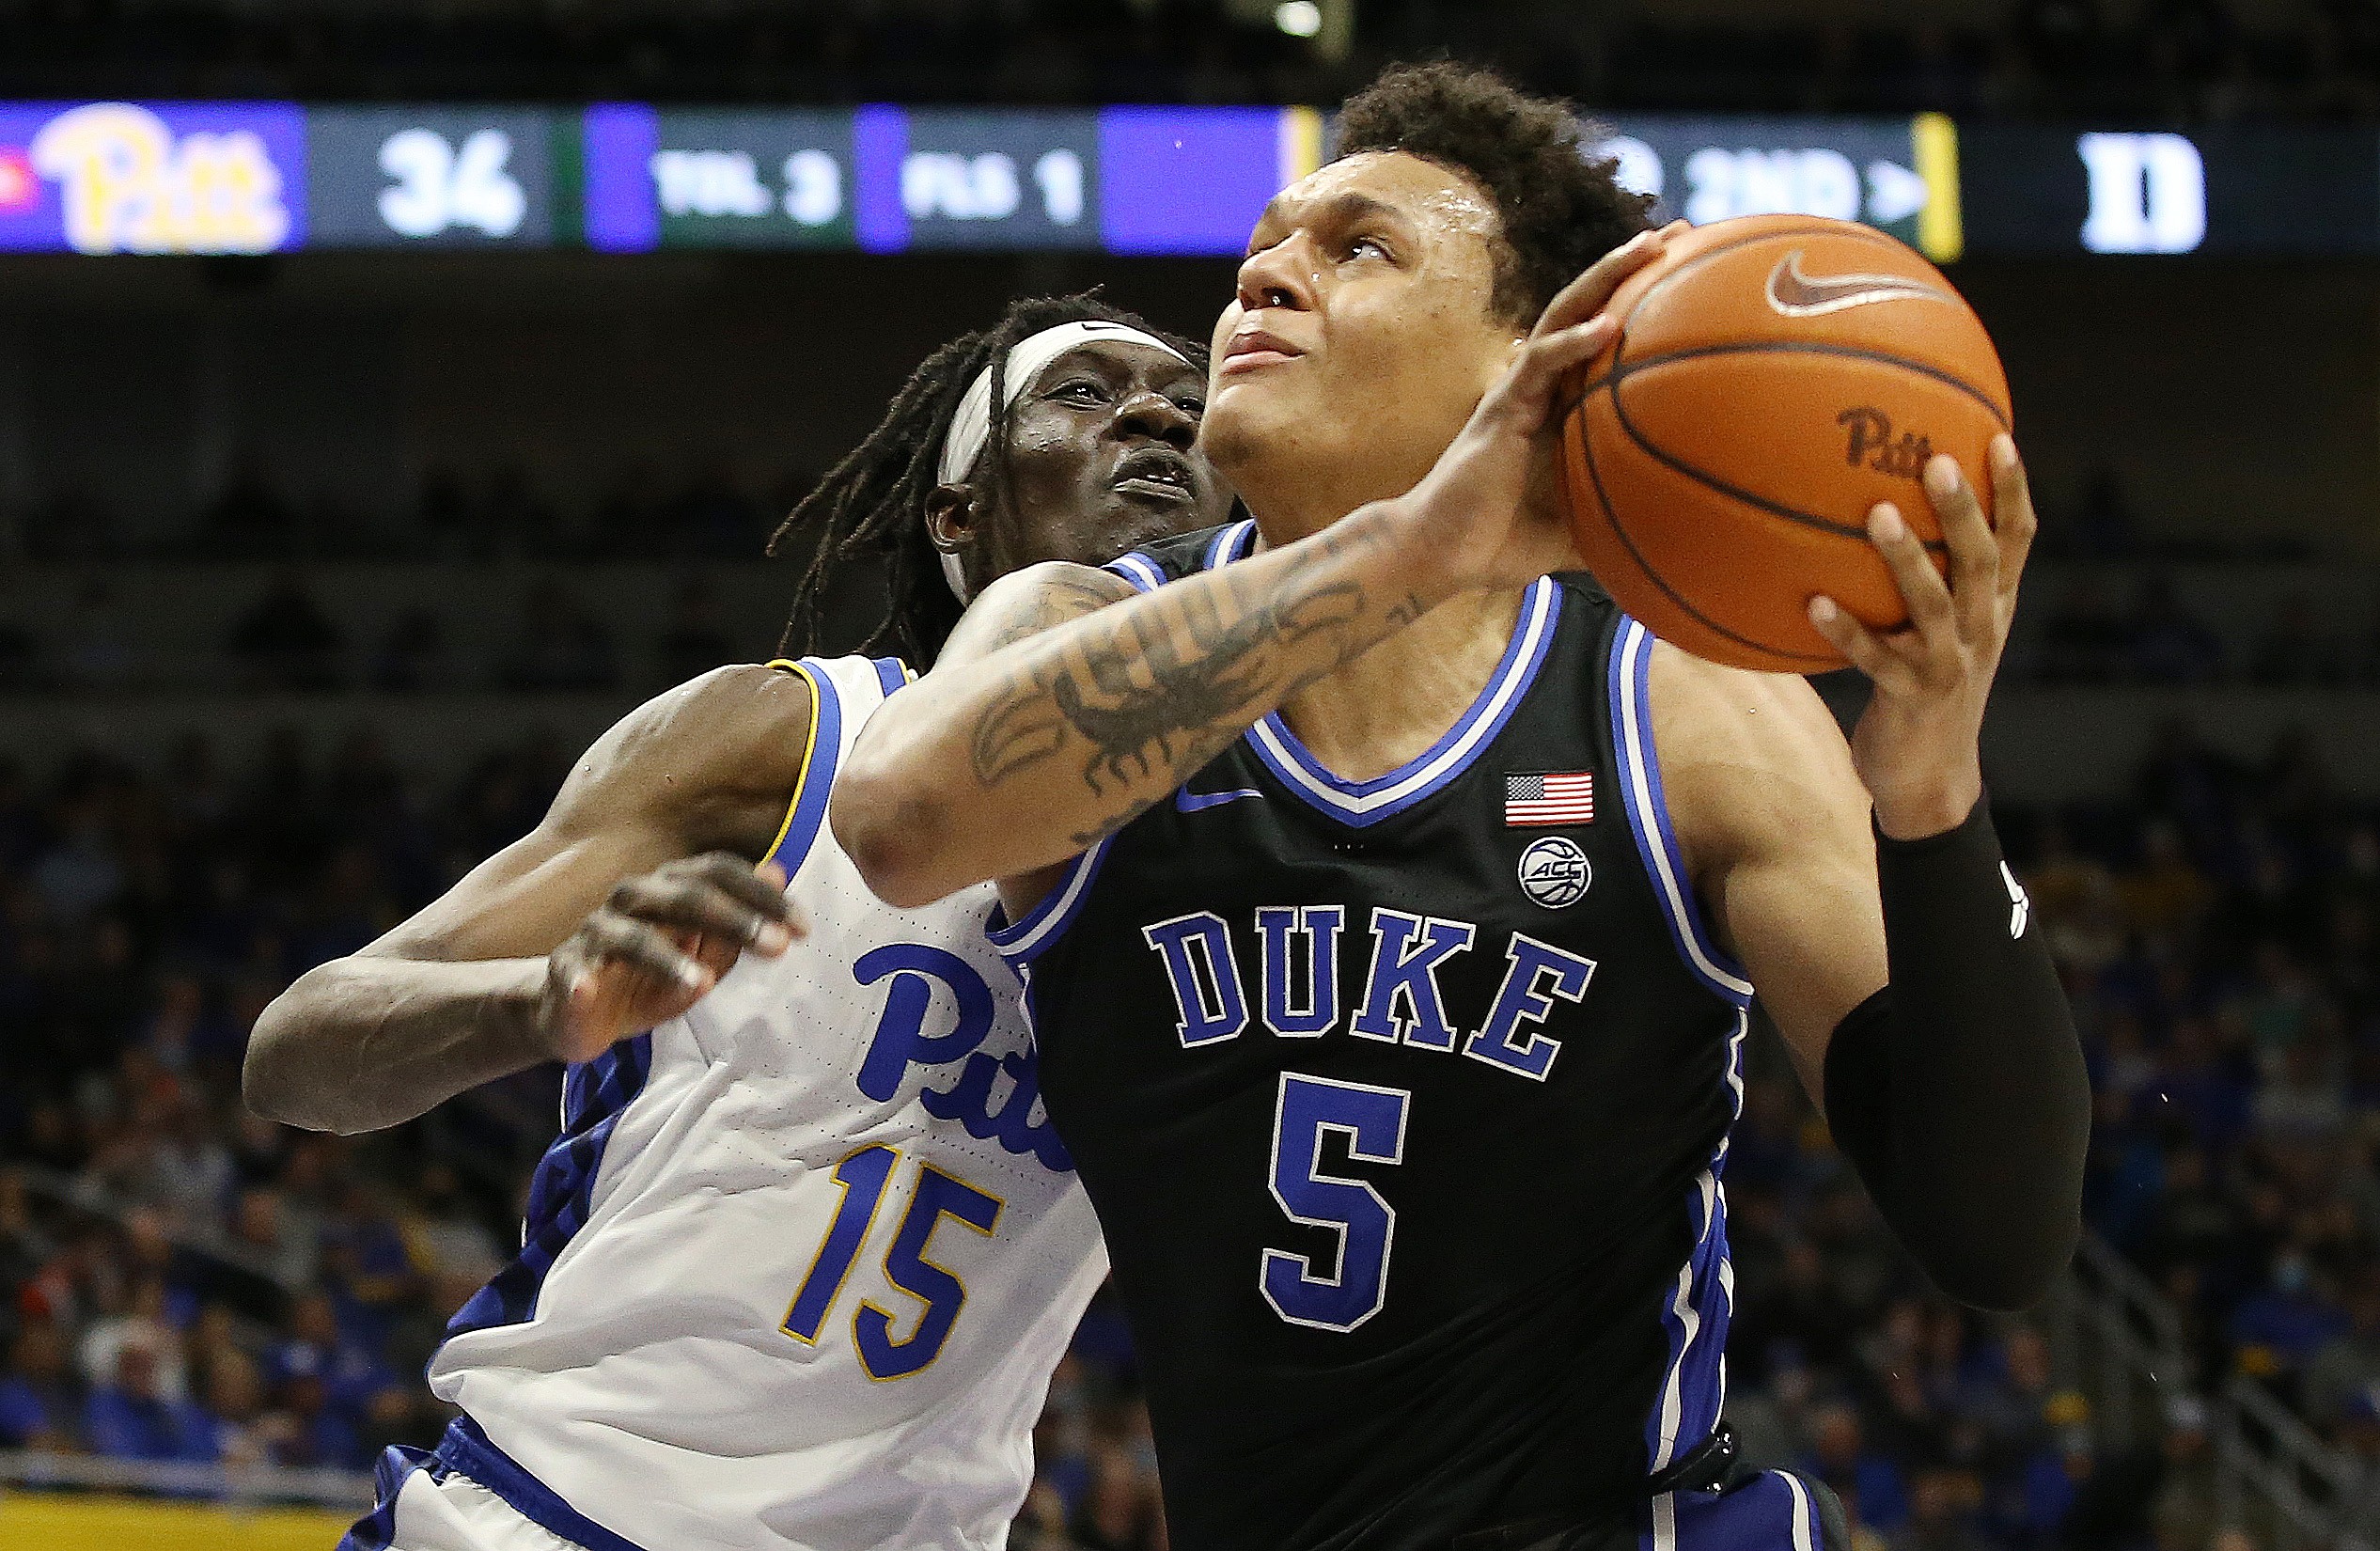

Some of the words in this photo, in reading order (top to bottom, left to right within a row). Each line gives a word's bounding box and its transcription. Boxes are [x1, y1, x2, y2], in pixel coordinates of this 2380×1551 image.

[783, 149, 842, 225] 3
[1034, 148, 1085, 226] 1
[2076, 132, 2209, 254] D
[1141, 904, 1597, 1082] DUKE
[778, 1142, 1005, 1383] 15
[1259, 1071, 1411, 1333] 5
